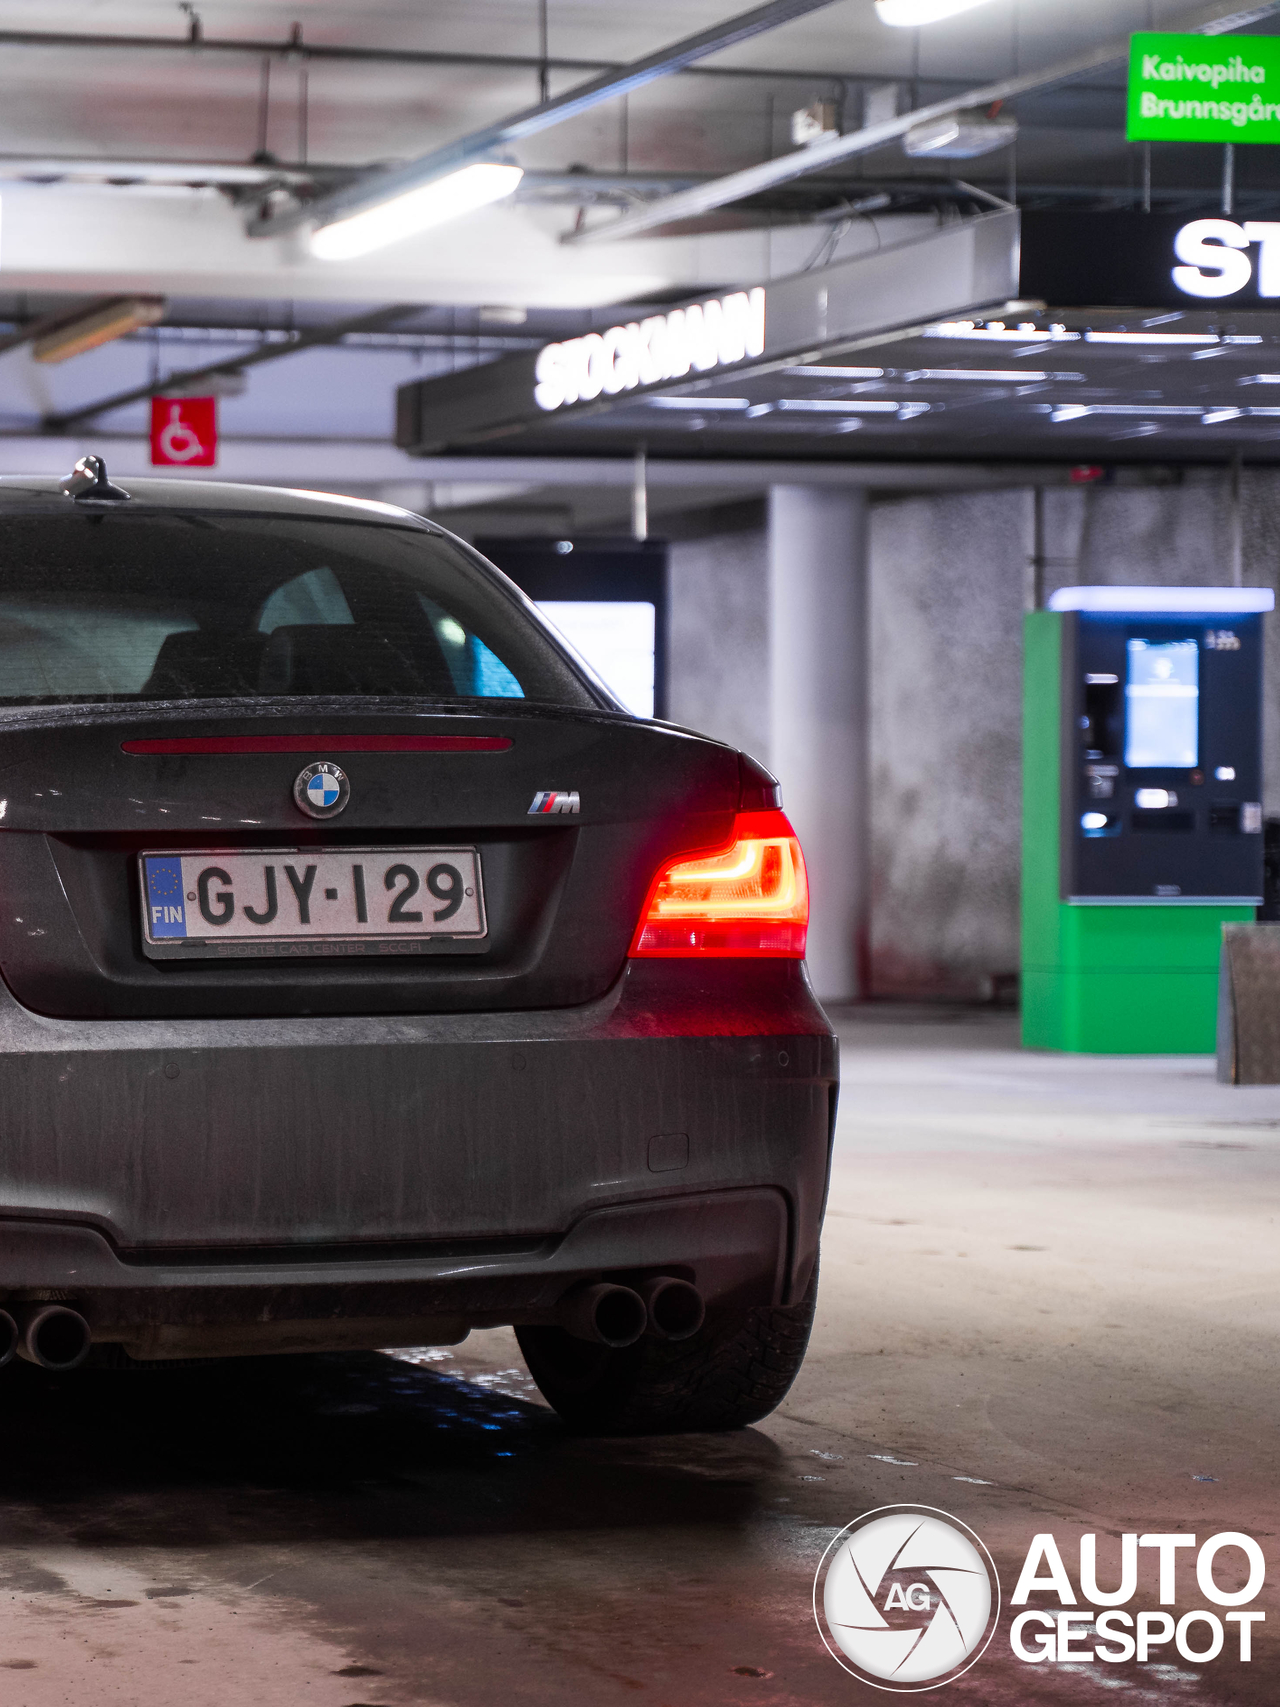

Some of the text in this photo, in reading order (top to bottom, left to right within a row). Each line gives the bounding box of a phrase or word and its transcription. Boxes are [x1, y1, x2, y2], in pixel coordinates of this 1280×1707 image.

[1141, 54, 1265, 89] Kaivopiha
[534, 286, 766, 411] STOCKMANN
[303, 764, 344, 781] BMW
[152, 905, 183, 924] FIN
[218, 945, 275, 956] SPORTS
[279, 944, 309, 955] CAR
[313, 943, 366, 954] CENTER
